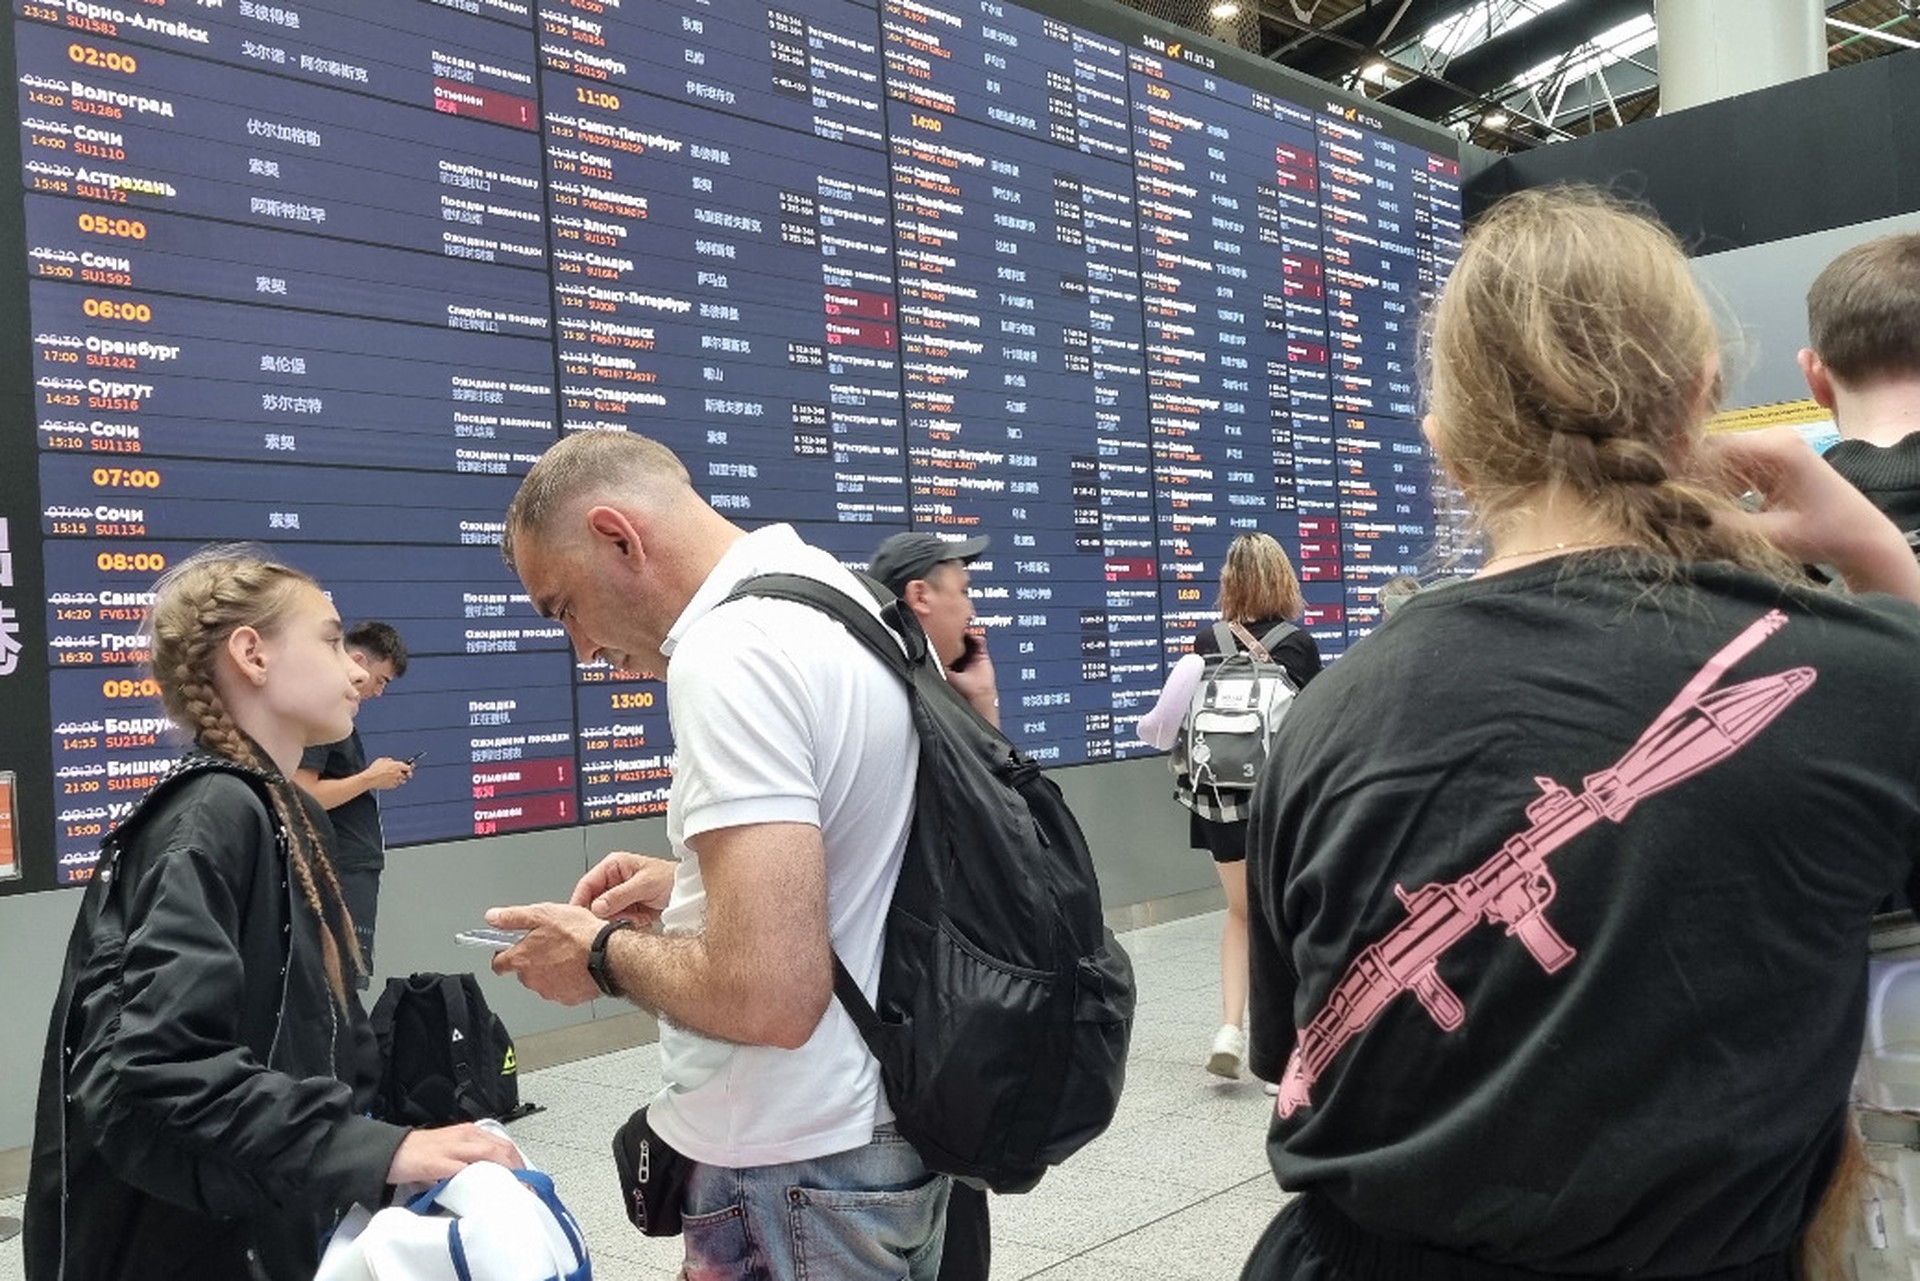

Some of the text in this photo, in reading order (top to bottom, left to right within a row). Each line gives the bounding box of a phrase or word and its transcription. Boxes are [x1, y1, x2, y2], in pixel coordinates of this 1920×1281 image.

[23, 5, 117, 36] 23:25 SU1582
[65, 0, 210, 43] Горно-Алтайск
[69, 43, 136, 74] 02:00
[28, 90, 123, 120] 14:20 SU1286
[71, 80, 175, 117] Волгоград
[576, 87, 620, 110] 11:00
[911, 114, 942, 133] 14:00
[73, 124, 123, 147] Сочи
[578, 118, 683, 153] Санкт-Петербург
[31, 134, 125, 161] 14:00 SU1110
[580, 151, 612, 169] Сочи
[33, 177, 127, 203] 15:45 SU1172
[75, 166, 177, 198] Астрахань
[78, 213, 147, 240] 05:00
[583, 218, 628, 238] Элиста
[80, 252, 130, 272] Сочи
[585, 252, 634, 272] Самара
[38, 263, 132, 286] 15:00 SU1592
[587, 285, 692, 313] Санкт-Петербург
[83, 298, 151, 322] 06:00
[590, 319, 655, 339] Мурманск
[85, 336, 180, 360] Оренбург
[43, 350, 137, 370] 17:00 SU1242
[591, 353, 637, 370] Казань
[88, 378, 154, 399] Сургут
[594, 388, 667, 406] Ставрополь
[45, 392, 140, 411] 14:25 SU1516
[262, 394, 322, 414] 苏尔古特
[90, 421, 140, 438] Сочи
[48, 436, 142, 452] 15:10 SU1138
[265, 434, 296, 452] 索契
[92, 468, 161, 489] 07:00
[94, 506, 144, 522] Сочи
[53, 522, 145, 535] 15:15 SU1134
[97, 553, 165, 571] 08:00
[100, 590, 156, 606] Санкт
[57, 609, 92, 620] 14:20
[101, 633, 151, 651] Гроз
[59, 652, 94, 663] 16:30
[469, 700, 516, 712] Посадка
[611, 692, 654, 709] 13:00
[612, 724, 644, 736] Сочи
[105, 734, 156, 749] SU2154
[1243, 764, 1254, 777] 3
[64, 781, 100, 794] 21:00
[66, 825, 101, 838] 15:00
